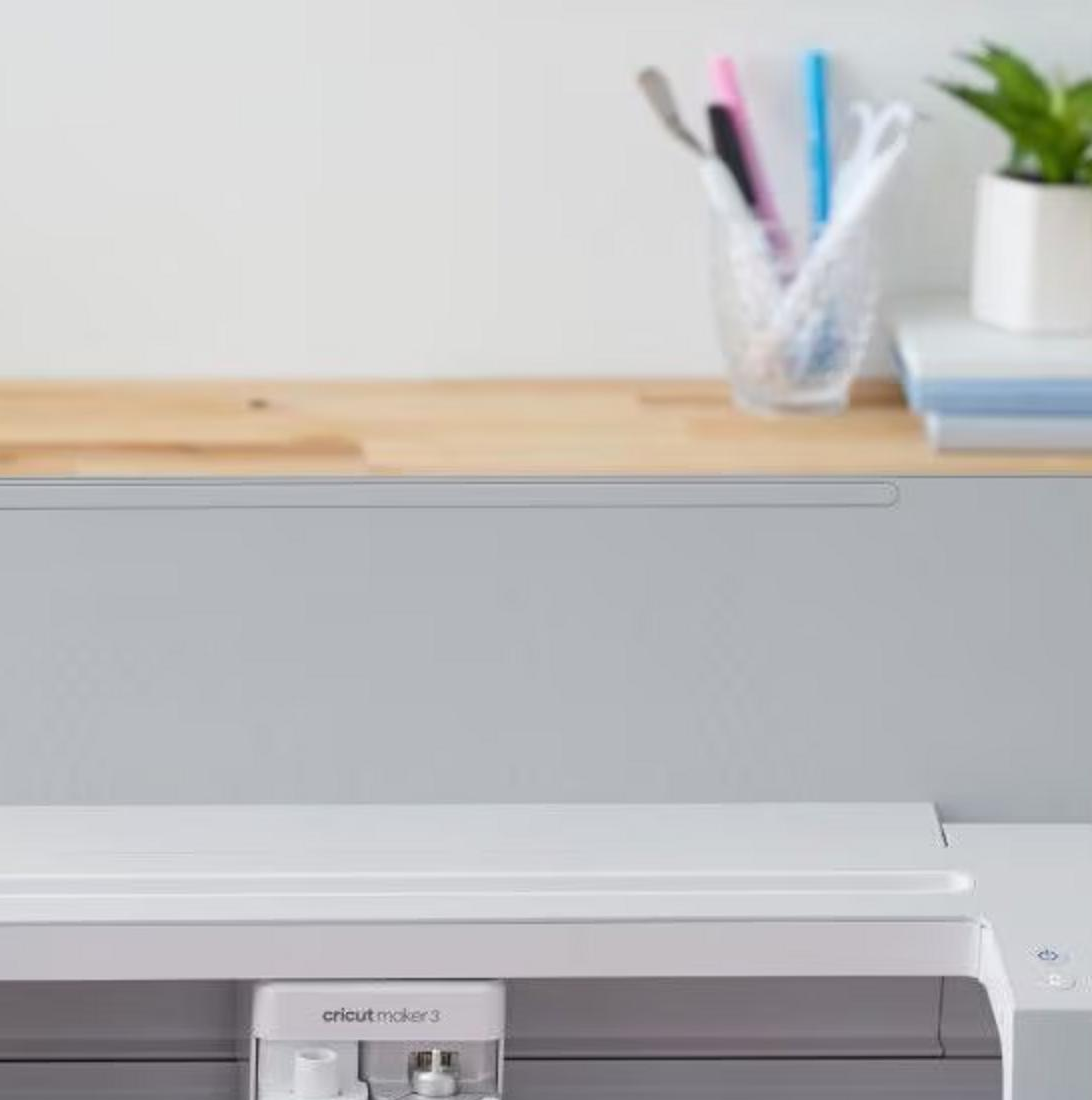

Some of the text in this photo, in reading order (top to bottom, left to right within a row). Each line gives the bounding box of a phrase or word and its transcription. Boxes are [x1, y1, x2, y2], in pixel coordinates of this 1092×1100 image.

[321, 1007, 440, 1023] cricut maker 3
